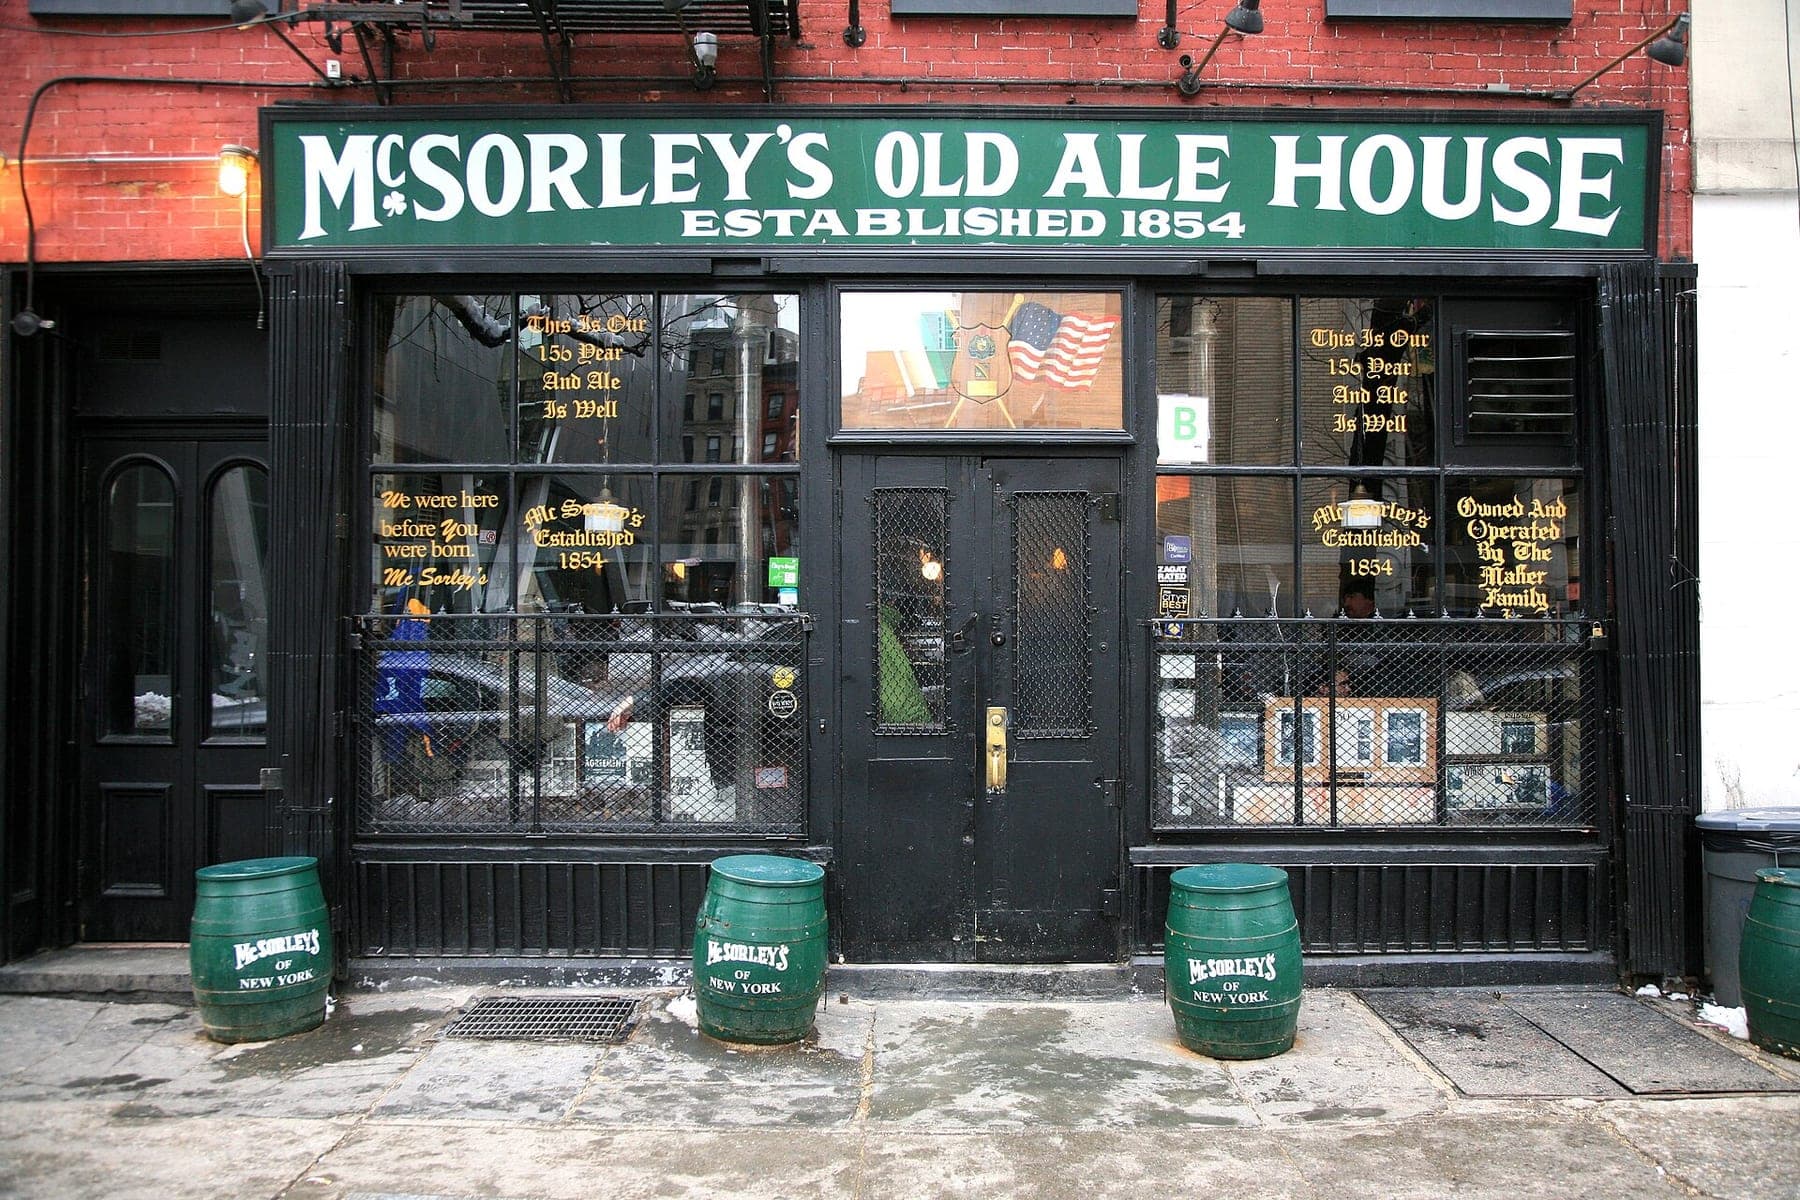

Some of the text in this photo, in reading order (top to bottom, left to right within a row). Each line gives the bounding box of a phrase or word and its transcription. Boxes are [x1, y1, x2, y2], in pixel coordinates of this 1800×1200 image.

[874, 130, 1019, 198] OLD
[1042, 132, 1231, 203] ALE
[1266, 133, 1624, 237] HOUSE
[681, 206, 1246, 239] ESTABLISHED 1854
[527, 314, 647, 337] This Is Our
[1310, 328, 1430, 350] This Is Our
[577, 342, 624, 365] Year
[1366, 356, 1412, 379] Year
[542, 370, 622, 391] And Ale
[1332, 385, 1409, 405] And Ale
[543, 399, 618, 419] Is Well
[1174, 406, 1197, 440] B
[1332, 413, 1407, 433] Is Well
[381, 489, 499, 508] We were here
[1457, 494, 1567, 519] Owned And
[381, 518, 437, 538] before
[440, 518, 480, 543] You
[534, 528, 634, 550] Established
[1322, 528, 1421, 550] Established
[1467, 518, 1560, 546] Operated
[384, 540, 475, 558] were born.
[1476, 540, 1553, 567] By The
[559, 551, 609, 570] 1854
[1157, 565, 1188, 573] ZAGAT
[1348, 558, 1394, 577] 1854
[383, 566, 489, 591] Mc Sorley's
[1162, 594, 1188, 603] CITY'S
[1162, 601, 1187, 609] BEST
[1480, 586, 1549, 614] Family
[275, 960, 293, 971] OF
[734, 970, 751, 980] OF
[240, 968, 314, 989] NEW YORK
[709, 976, 782, 994] NEW YORK
[1223, 982, 1240, 991] OF
[1193, 990, 1269, 1004] NEW YORK
